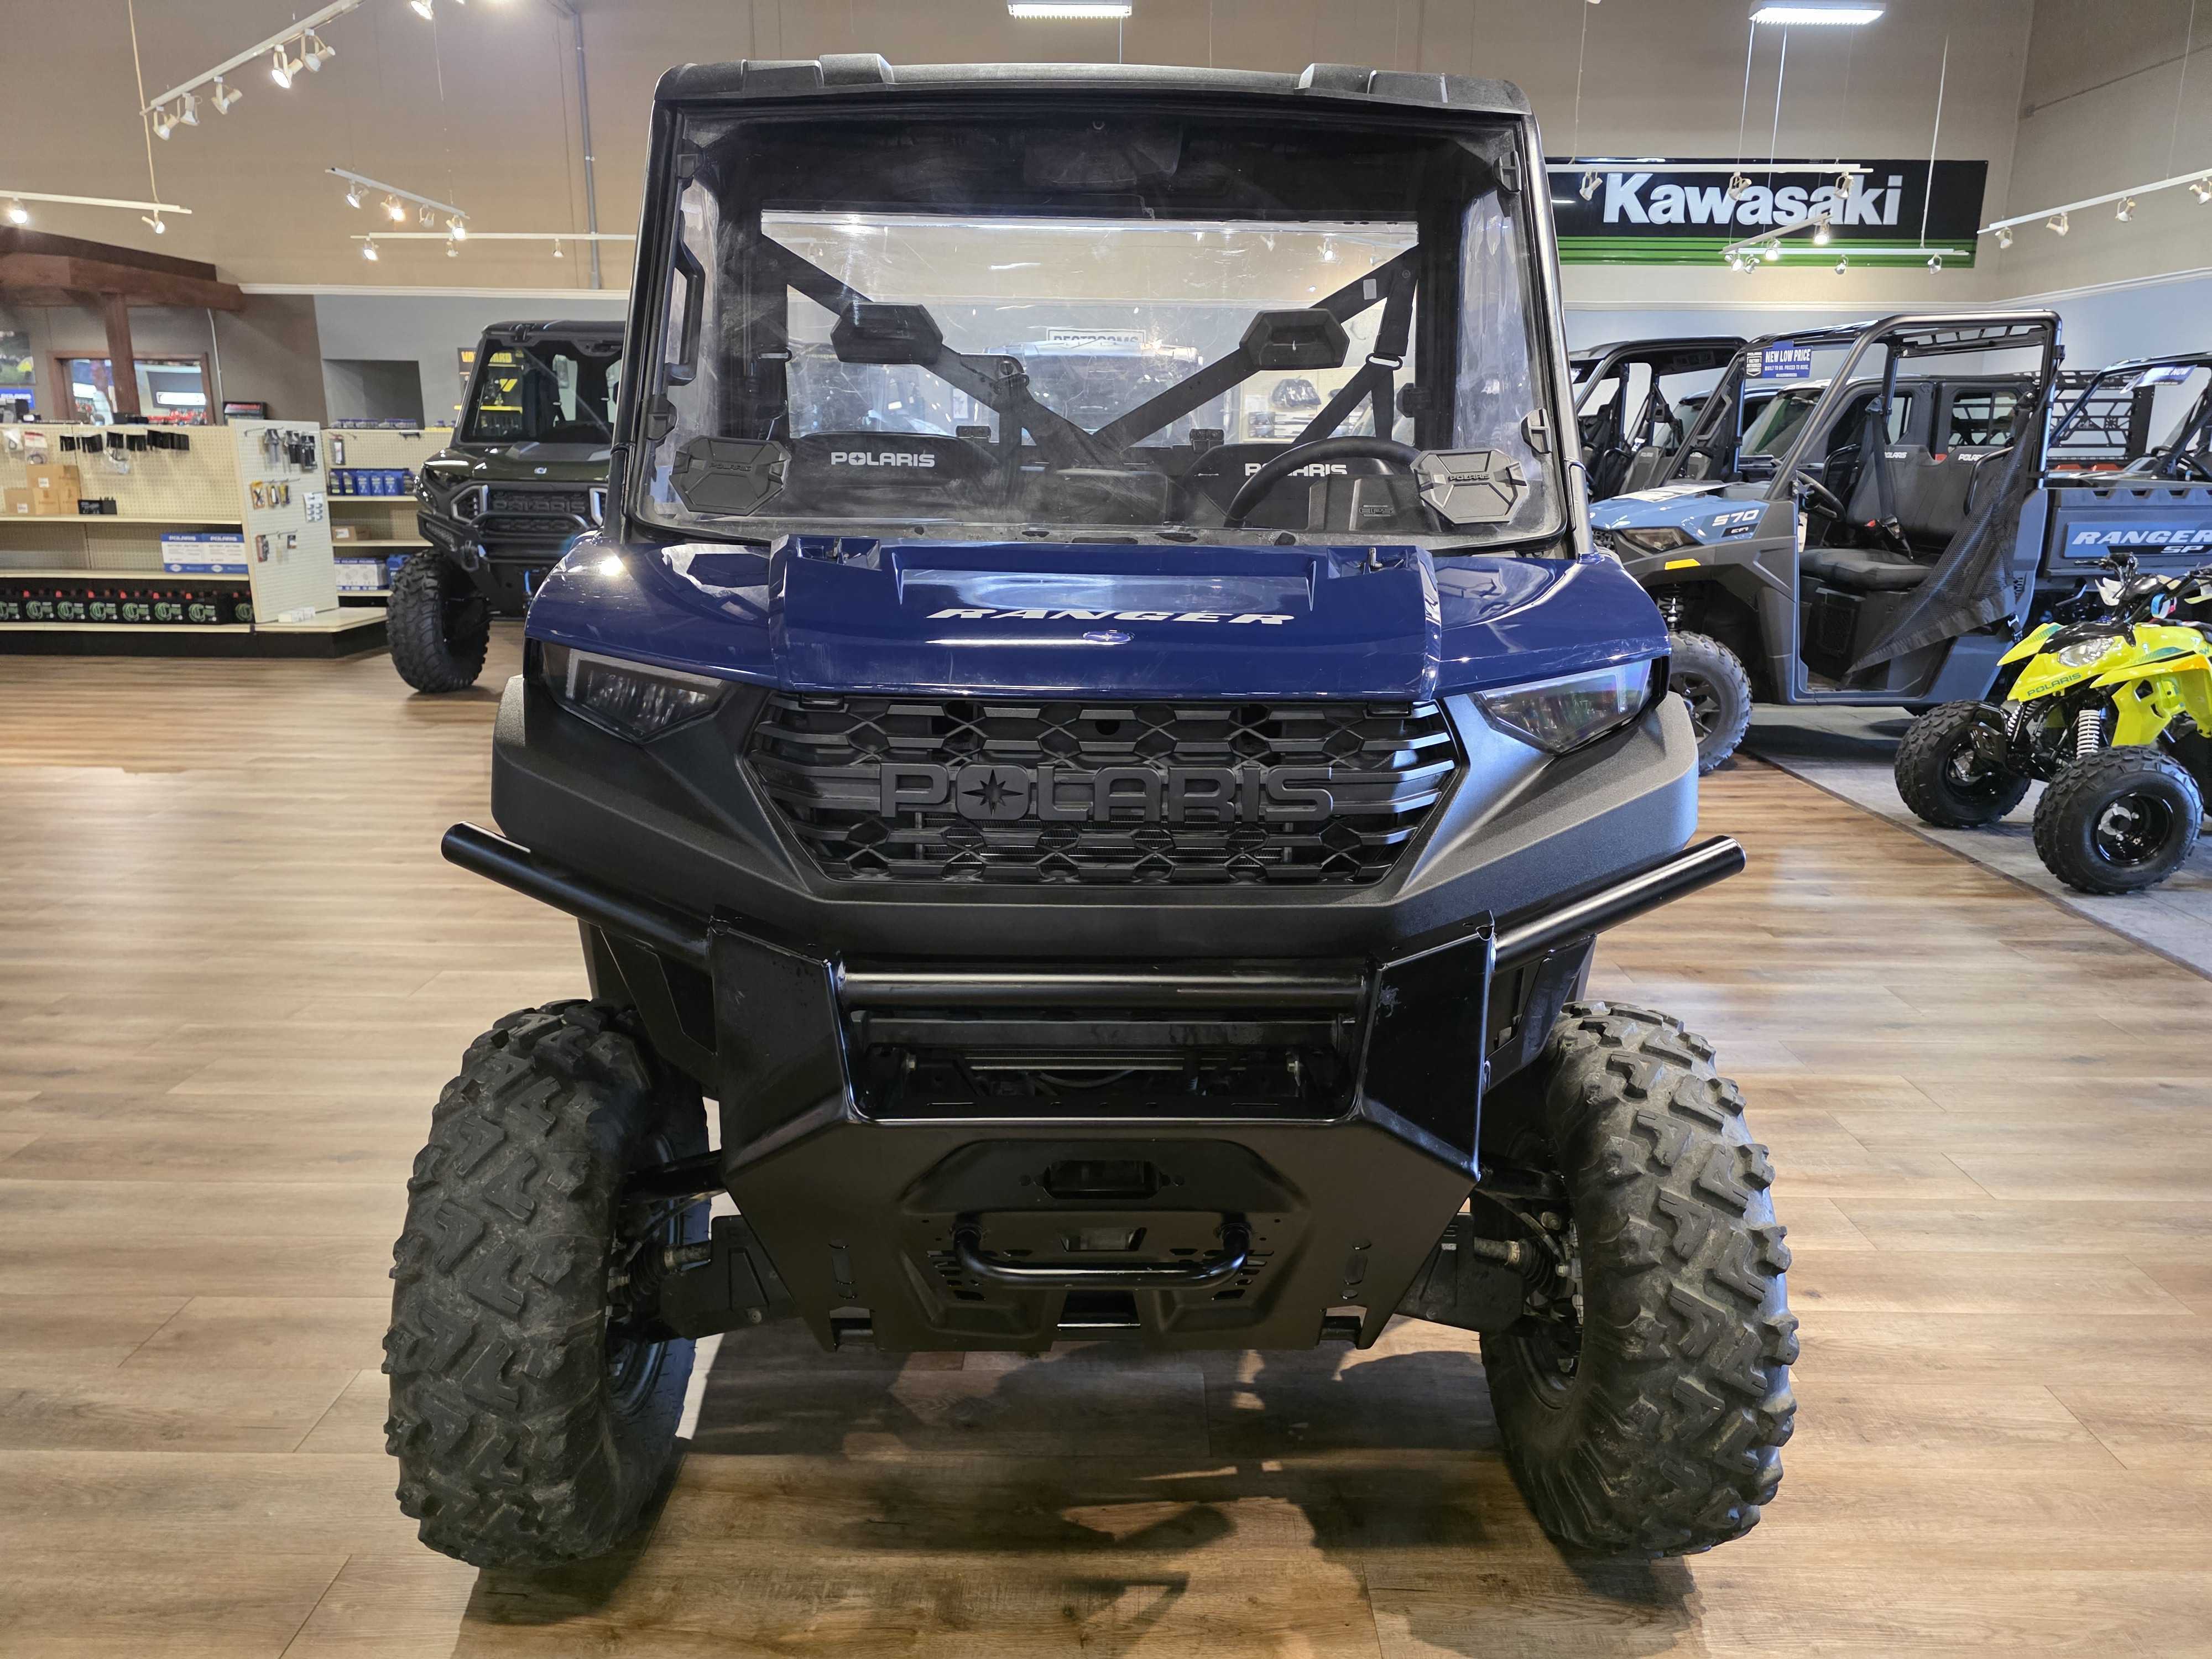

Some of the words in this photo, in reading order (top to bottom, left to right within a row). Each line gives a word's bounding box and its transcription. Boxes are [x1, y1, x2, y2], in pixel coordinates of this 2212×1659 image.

[1604, 173, 1903, 226] Kawasaki
[1766, 351, 1779, 363] NEW
[1780, 350, 1793, 362] LOW
[1794, 348, 1811, 362] PRICE
[831, 452, 935, 467] POLARIS
[709, 463, 752, 472] POLARIS
[1245, 463, 1348, 477] PARIS
[1448, 474, 1491, 482] POLARIS
[1712, 509, 1759, 526] 570
[2161, 545, 2204, 554] SP
[926, 608, 1295, 625] RANGER
[2027, 672, 2081, 696] POLARIS
[880, 761, 1334, 823] POLARIS
